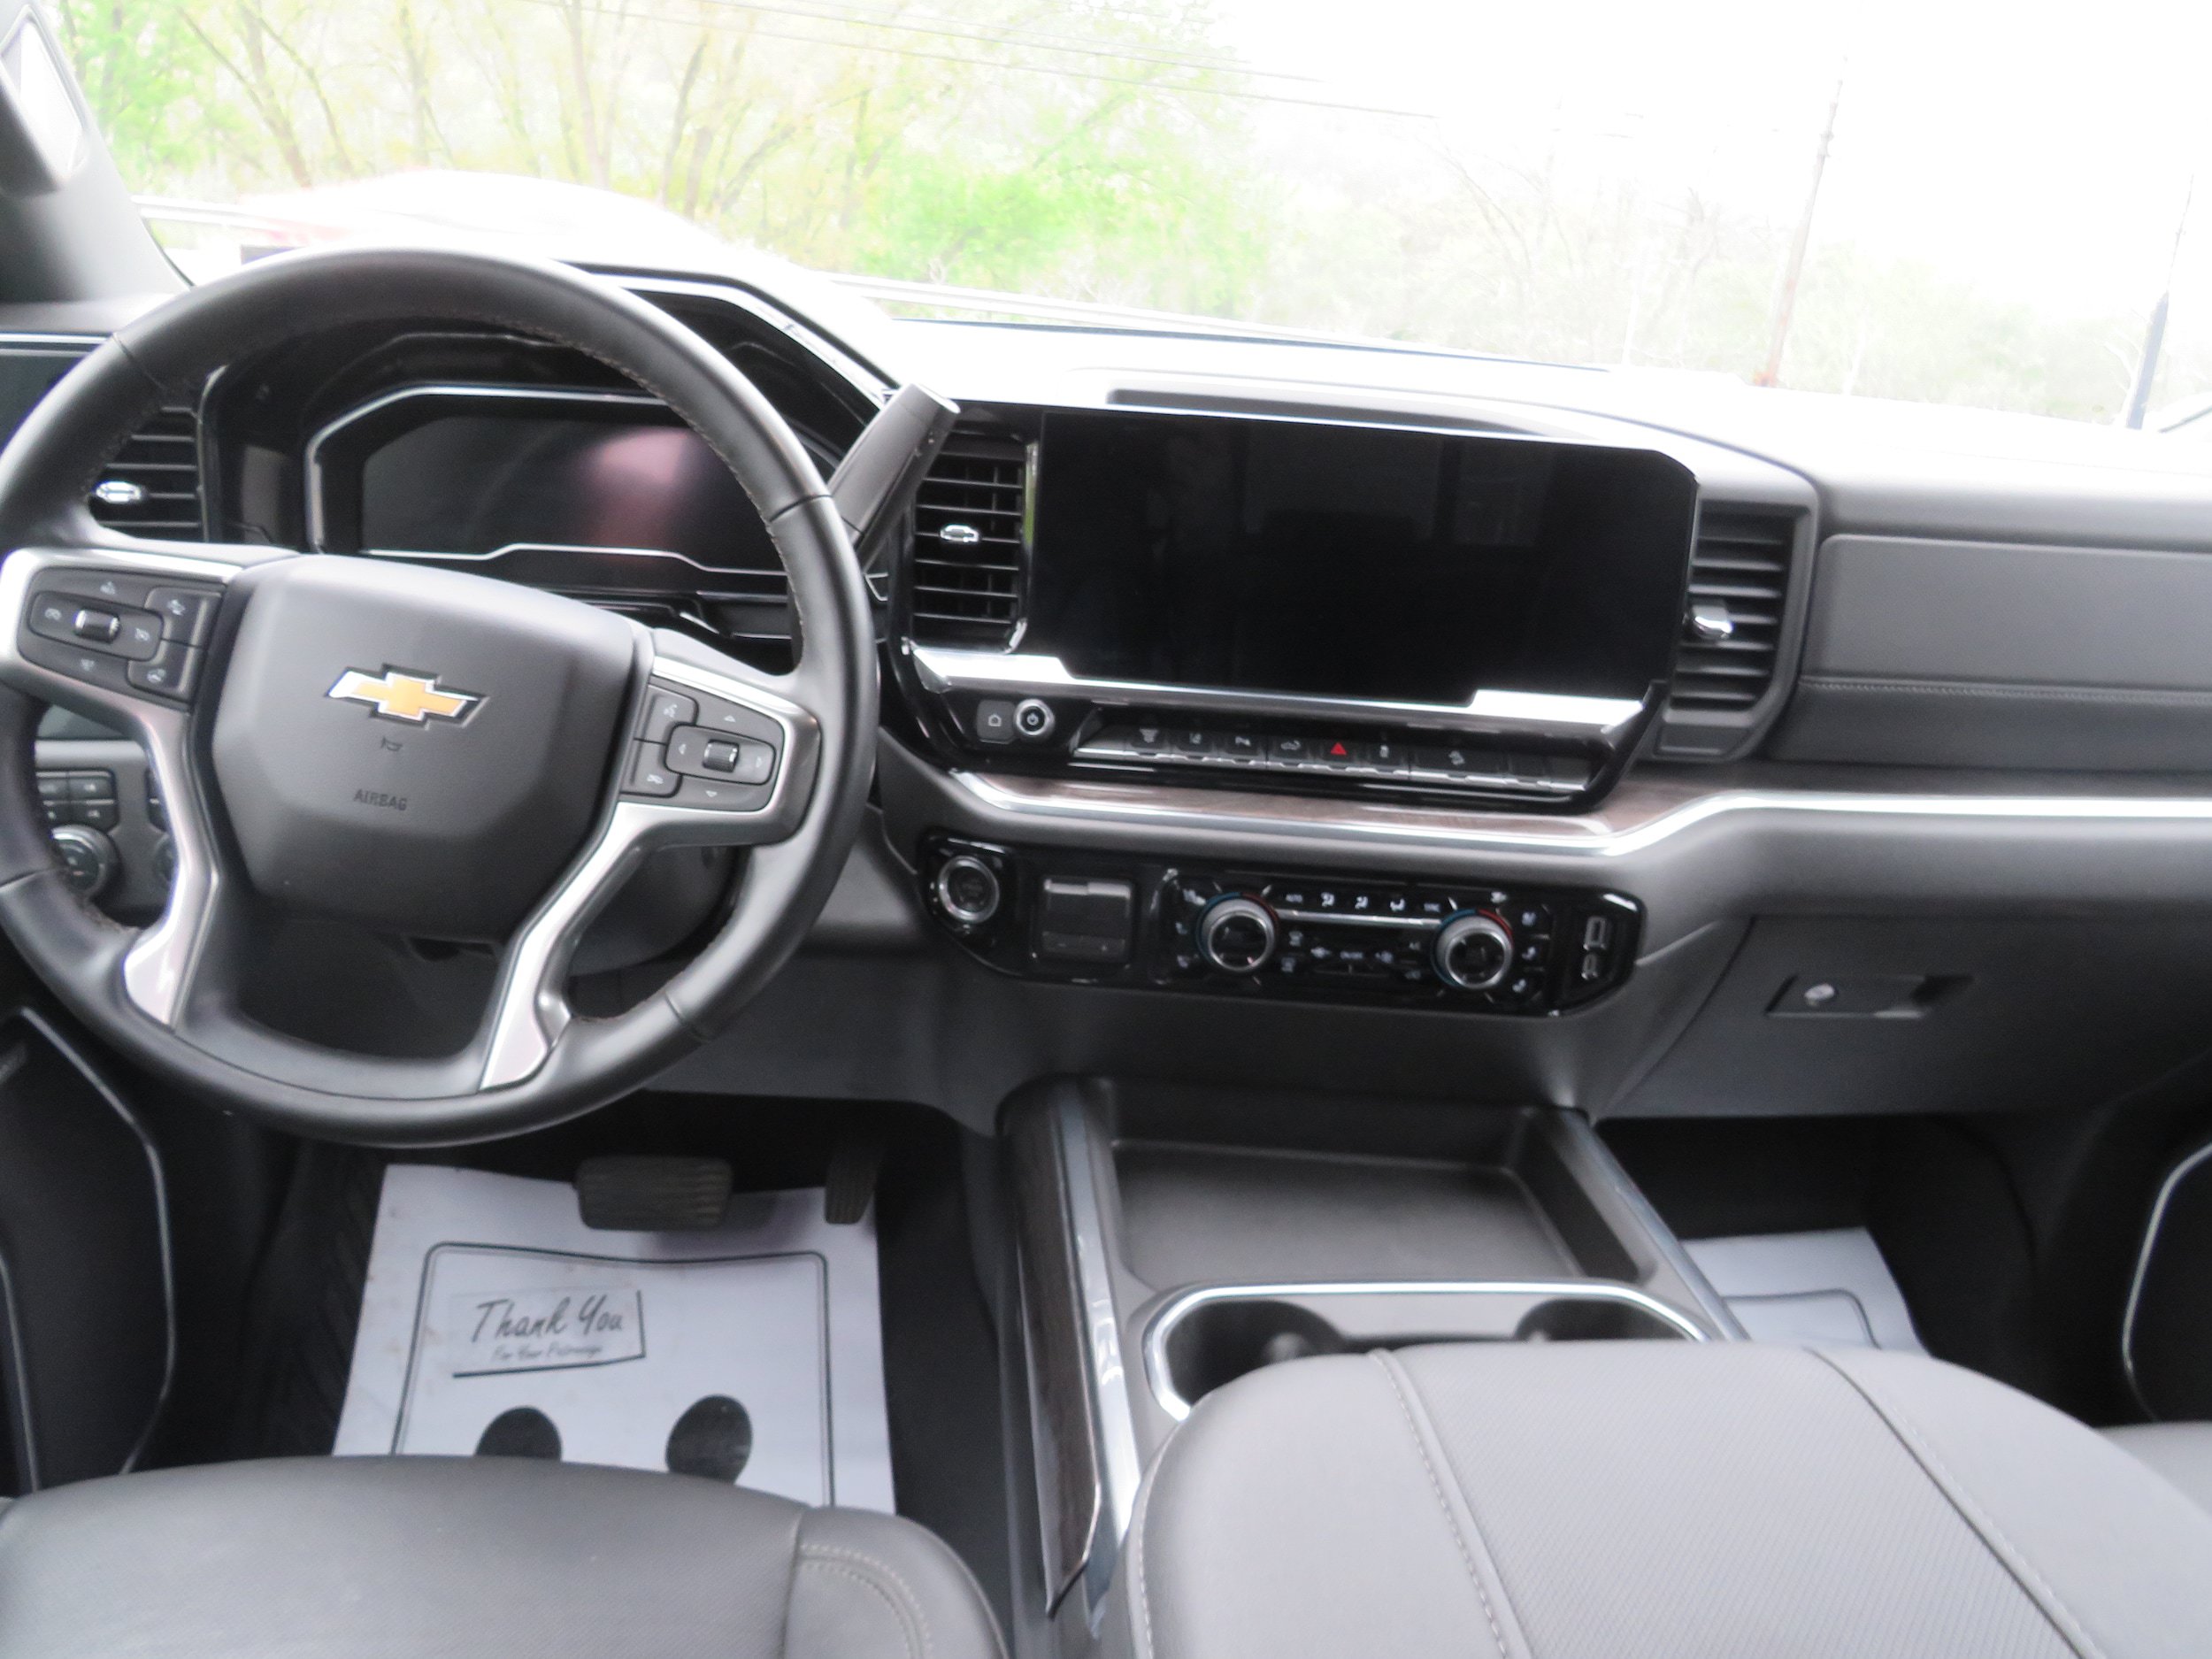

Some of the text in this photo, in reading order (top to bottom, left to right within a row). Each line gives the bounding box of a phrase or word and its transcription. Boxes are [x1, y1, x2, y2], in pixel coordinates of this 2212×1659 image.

[353, 788, 408, 811] AIRBAG
[471, 1294, 623, 1343] Thank You
